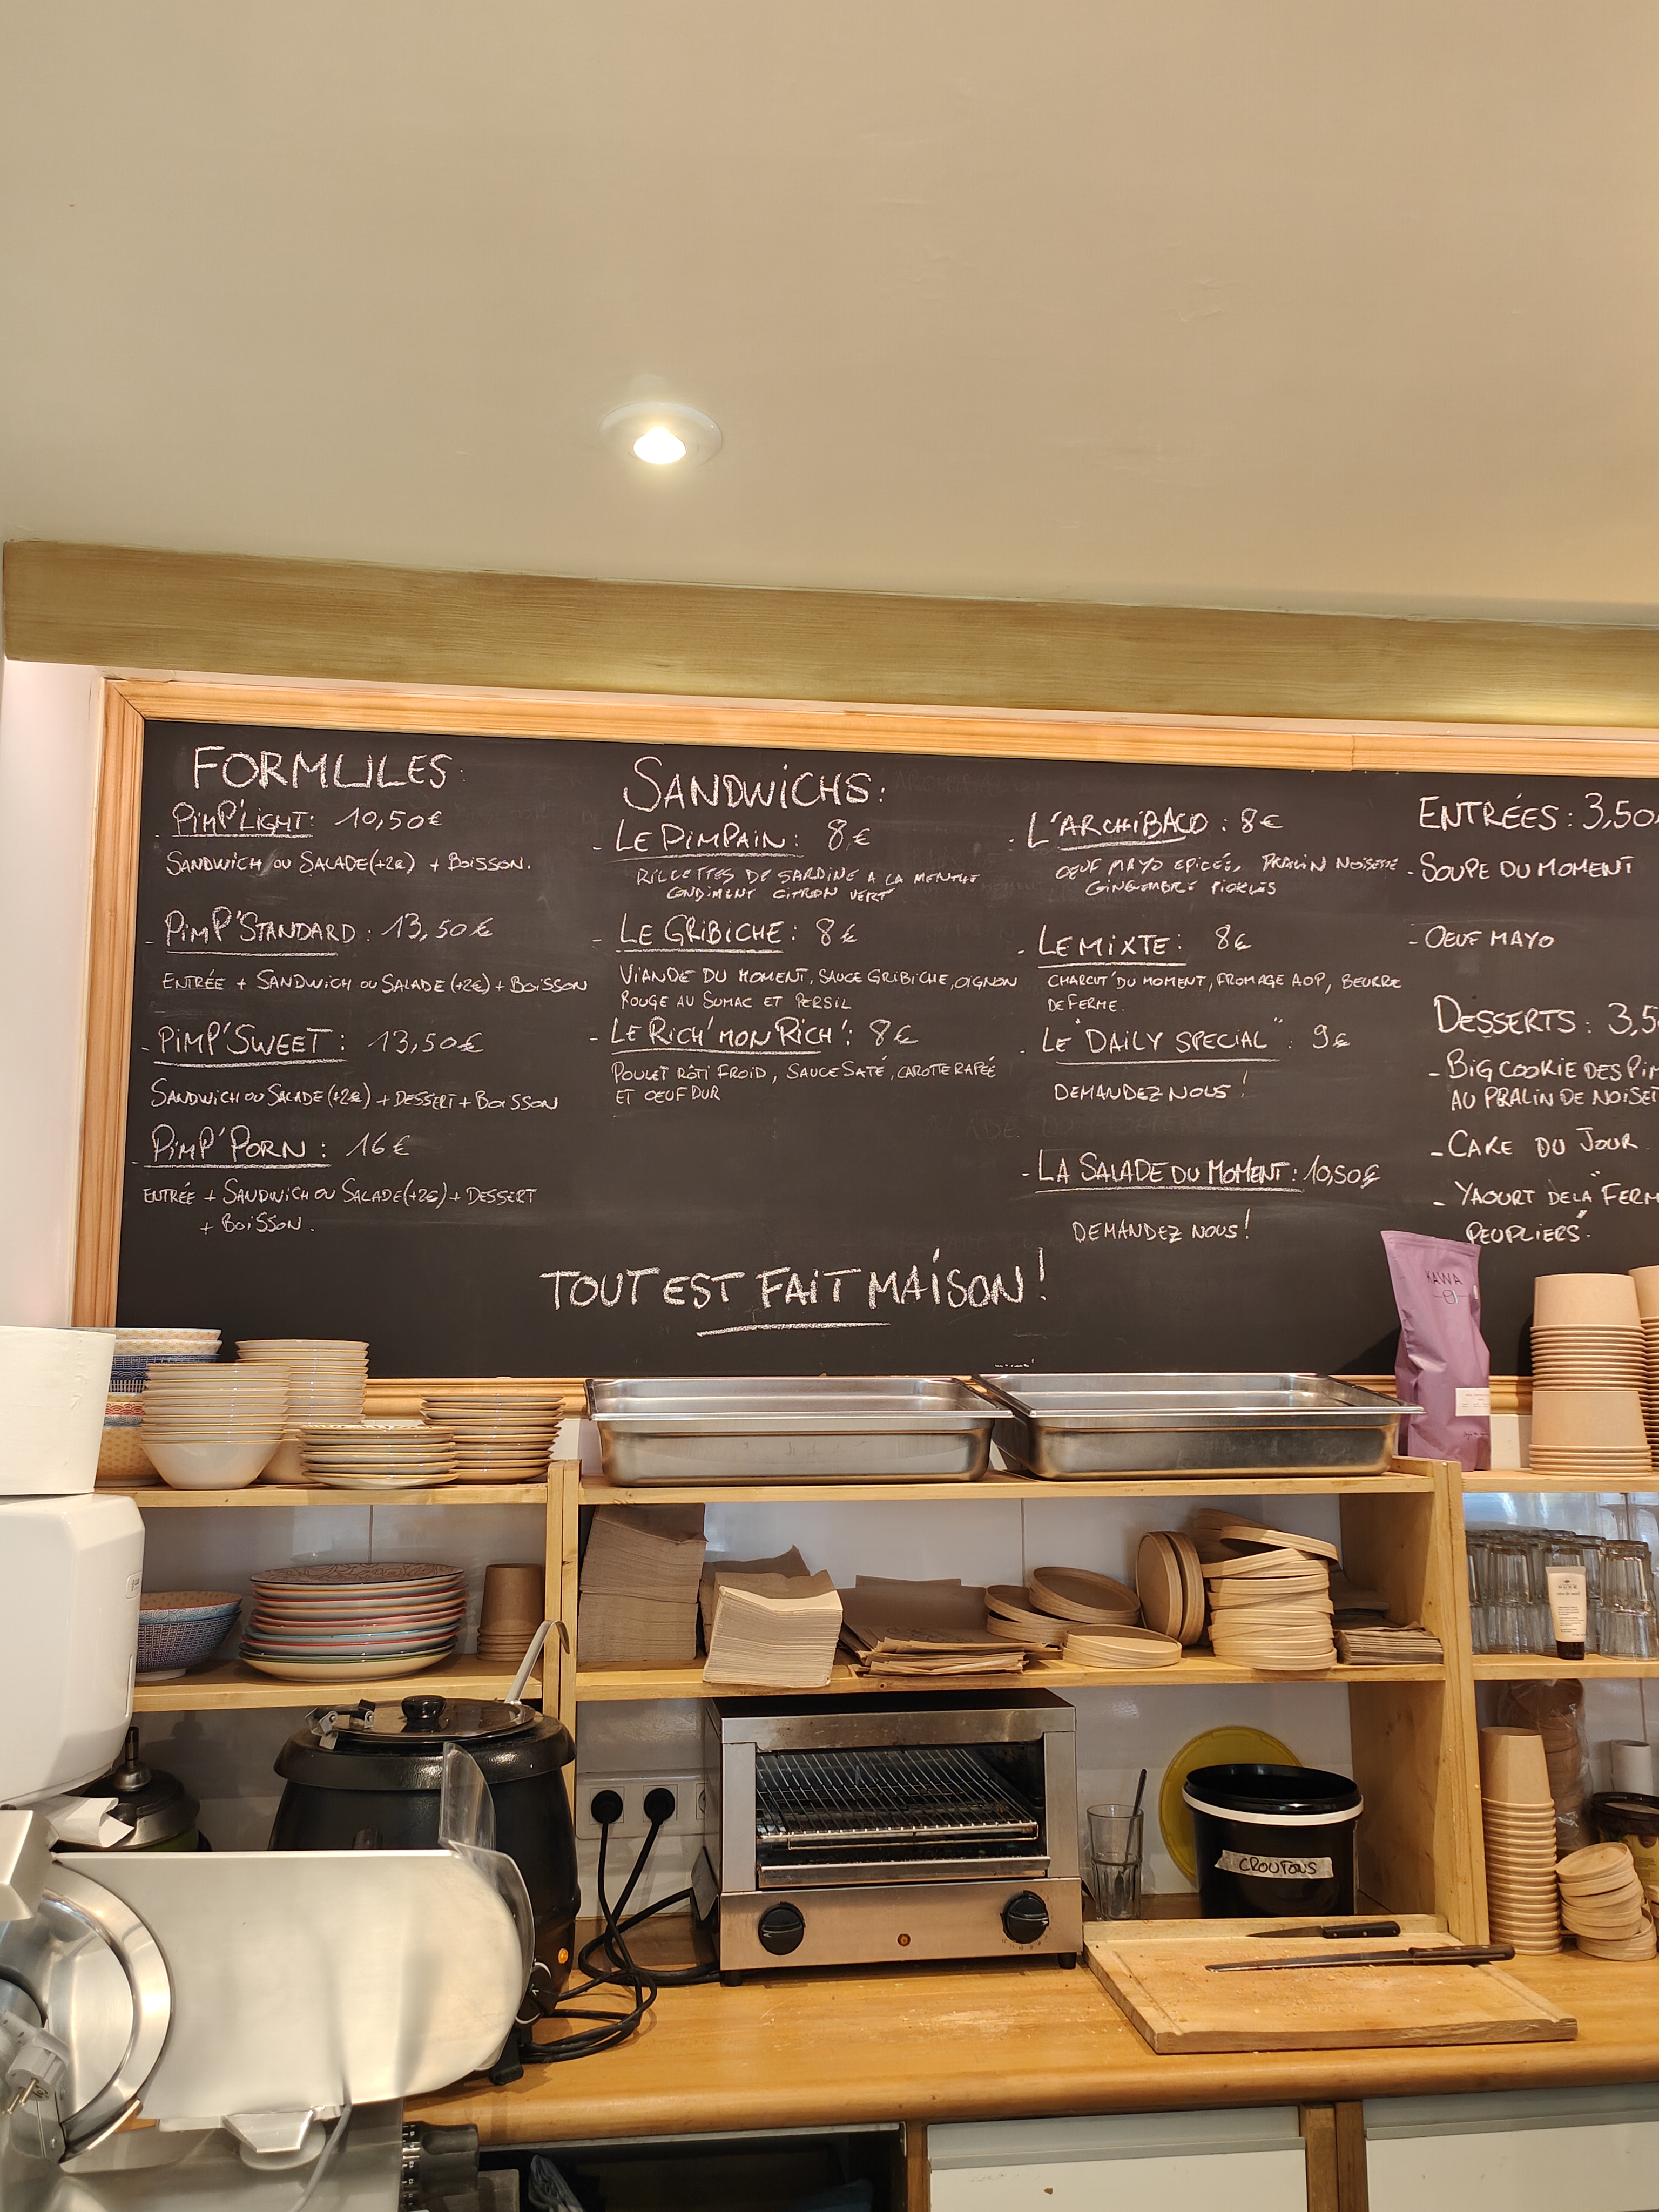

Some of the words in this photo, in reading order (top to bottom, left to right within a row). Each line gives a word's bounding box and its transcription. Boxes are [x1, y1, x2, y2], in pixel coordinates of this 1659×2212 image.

[194, 745, 467, 790] FORMULES:
[334, 807, 442, 831] 10,50€
[1582, 792, 1659, 830] 3,50
[616, 818, 653, 852] LE
[1108, 857, 1163, 876] MAYO
[1420, 851, 1491, 883] SOUPE
[1500, 861, 1532, 879] DU
[1537, 855, 1635, 878] MOMENT
[381, 912, 494, 942] 13,50€
[620, 913, 653, 946] LE
[1038, 924, 1069, 957] LE
[1490, 930, 1555, 949] MAYO
[702, 967, 727, 984] DU
[819, 968, 863, 984] SAUCE
[1116, 976, 1136, 990] DU
[1216, 972, 1285, 989] FROMAGE
[621, 989, 669, 1011] ROUGE
[677, 995, 694, 1008] AU
[703, 990, 753, 1009] SUMAC
[763, 995, 783, 1007] ET
[1608, 1002, 1659, 1036] 3,5
[367, 1030, 484, 1054] 13,50€
[611, 1017, 643, 1044] LE
[719, 1028, 772, 1049] MON
[1042, 1027, 1071, 1053] LE
[611, 1061, 670, 1083] POULET
[786, 1063, 841, 1080] SAUCE
[1583, 1061, 1622, 1082] DES
[393, 1090, 457, 1110] DESSERT
[616, 1088, 635, 1105] ET
[691, 1084, 721, 1101] DUR
[1054, 1083, 1164, 1102] DEMANDEZ
[1451, 1089, 1476, 1111] AU
[1559, 1088, 1584, 1106] DE
[1448, 1129, 1513, 1158] CAKE
[1534, 1137, 1566, 1158] DU
[1038, 1149, 1070, 1184] LA
[1078, 1152, 1169, 1183] SALADE
[1171, 1165, 1201, 1184] DU
[1303, 1155, 1381, 1189] 10,50€
[466, 1186, 538, 1206] DESSERT
[1454, 1181, 1536, 1206] YAOURT
[1071, 1219, 1183, 1244] DEMANDEZ
[539, 1267, 661, 1310] TOUT
[662, 1271, 746, 1310] EST
[1425, 1270, 1464, 1285] KAWA
[1239, 1856, 1317, 1876] CROUTONS
